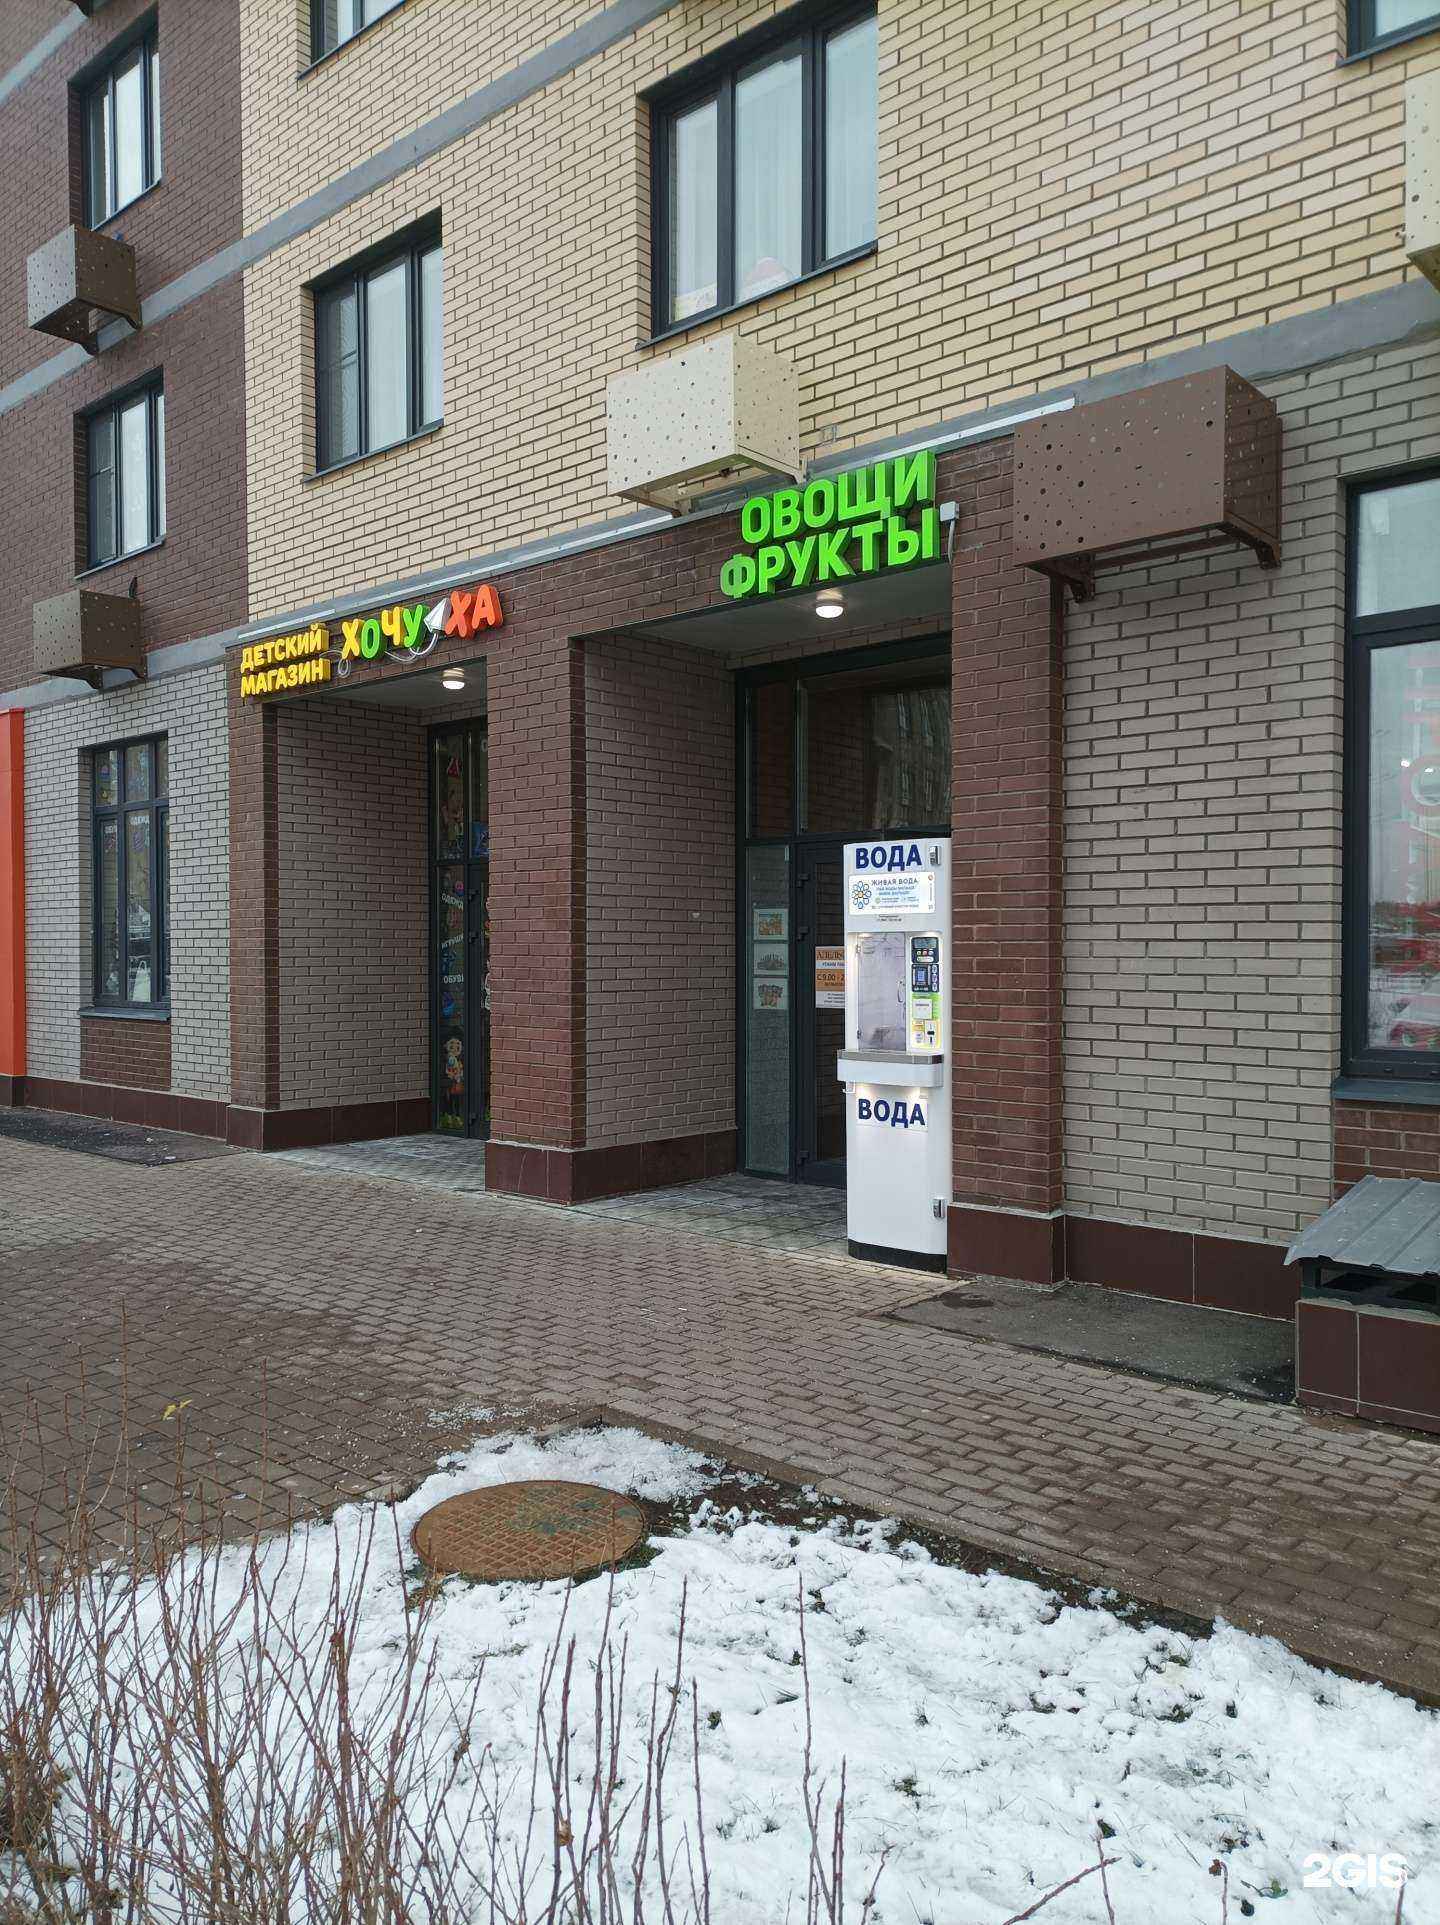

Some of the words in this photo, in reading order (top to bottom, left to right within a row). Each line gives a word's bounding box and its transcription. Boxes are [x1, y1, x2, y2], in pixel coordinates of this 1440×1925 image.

[741, 449, 936, 544] ОВОЩИ
[720, 507, 940, 599] ФРУКТЫ
[240, 622, 329, 673] ДЕТСКИЙ
[240, 657, 331, 698] МАГАЗИН
[855, 843, 923, 872] ВОДА
[858, 1098, 926, 1129] ВОДА
